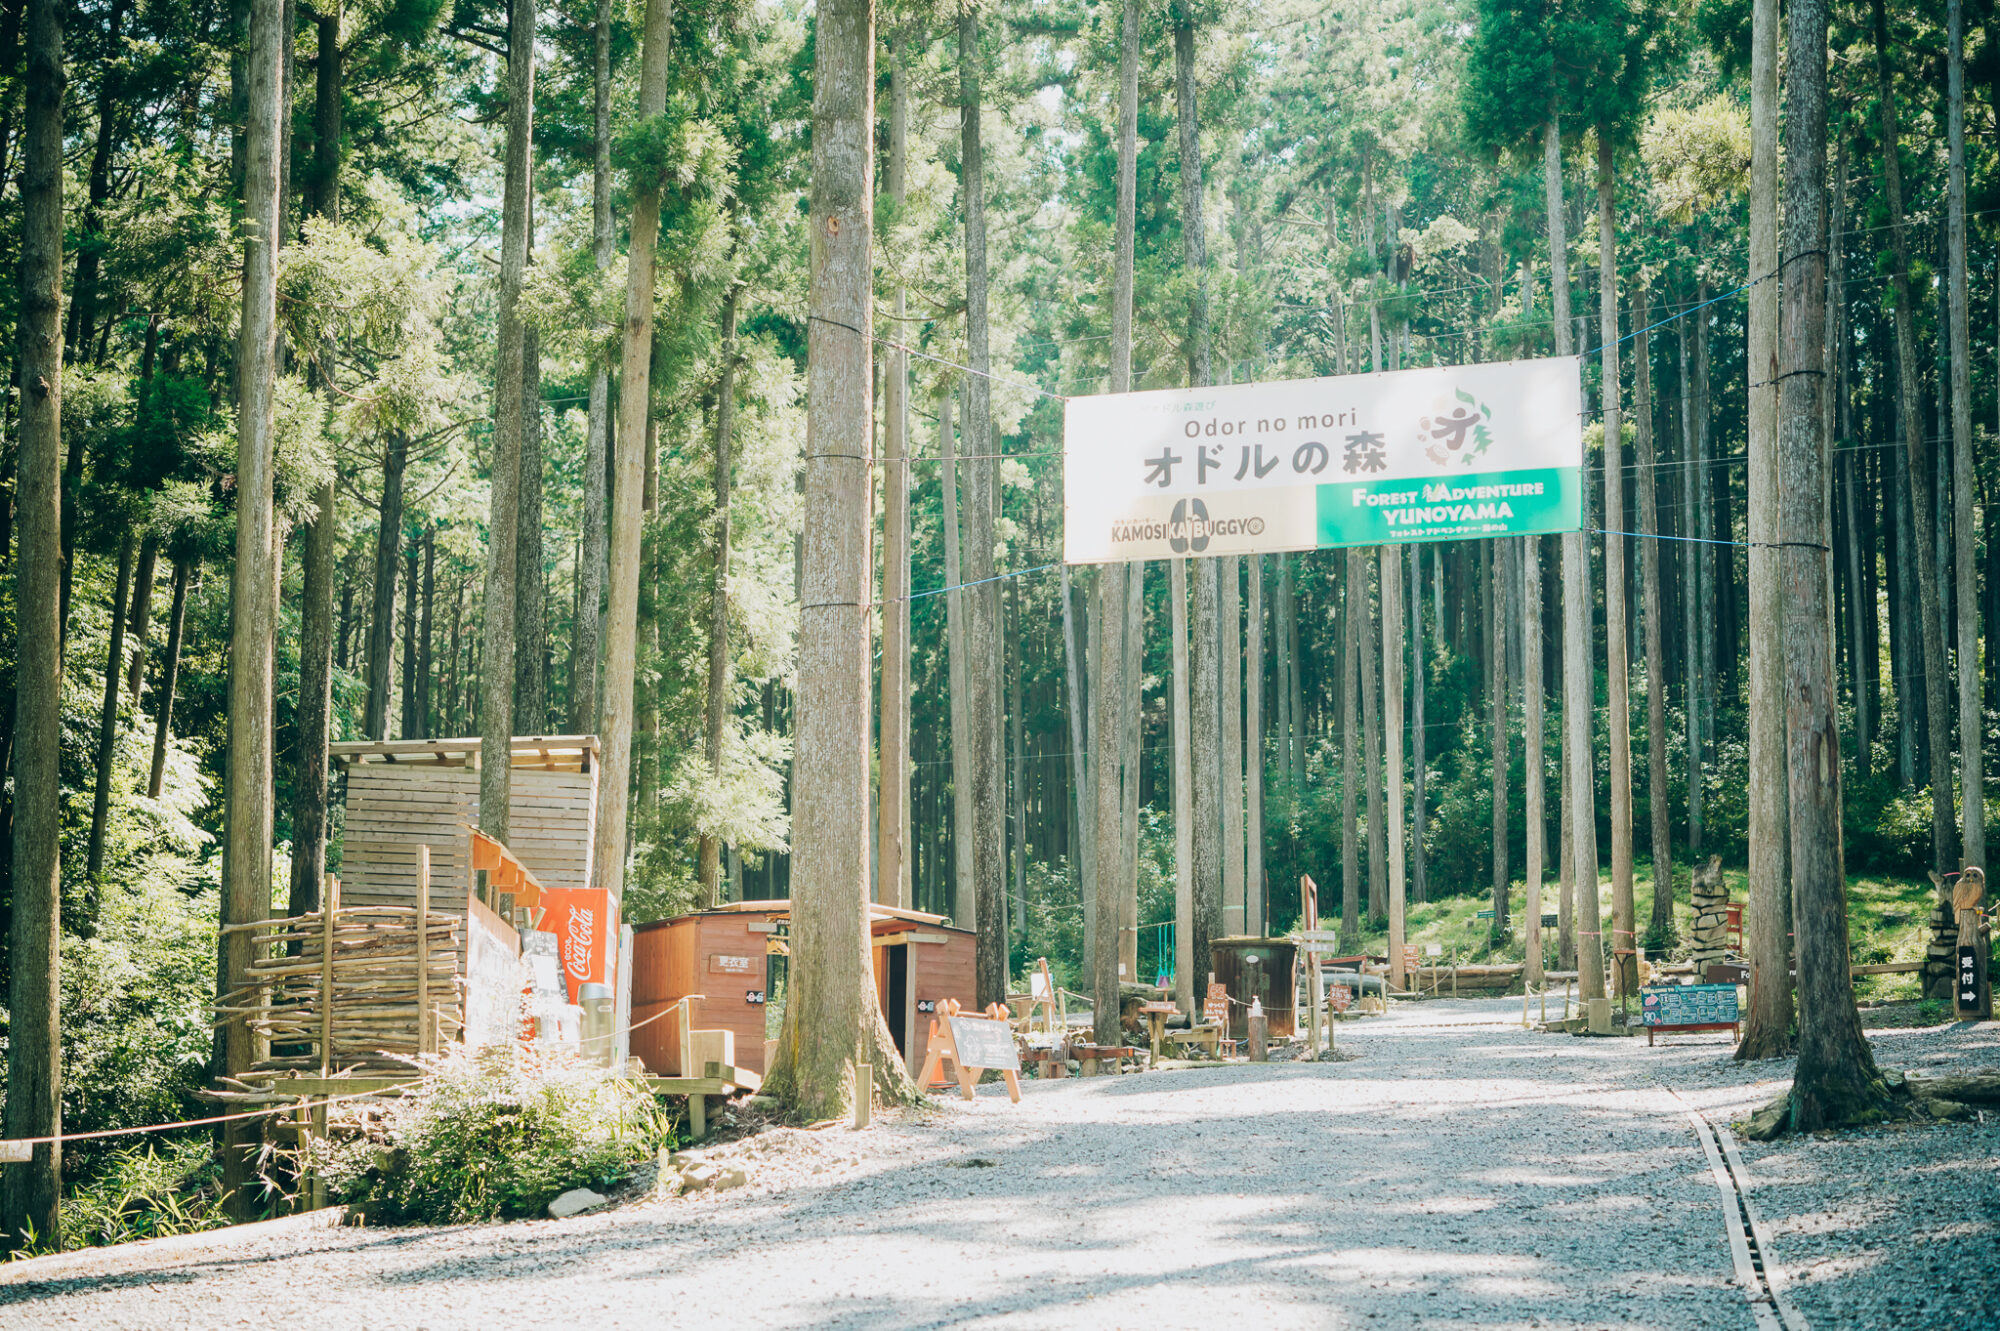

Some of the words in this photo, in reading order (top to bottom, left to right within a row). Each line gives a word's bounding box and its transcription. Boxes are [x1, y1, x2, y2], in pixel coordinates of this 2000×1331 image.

[1185, 418, 1247, 438] Odor
[1257, 417, 1287, 433] no
[1297, 407, 1358, 430] mori
[1143, 431, 1387, 488] オドルの森
[1382, 501, 1514, 526] YUNOYAMA
[567, 904, 594, 981] Coca-Cola
[1961, 956, 1974, 985] 受付
